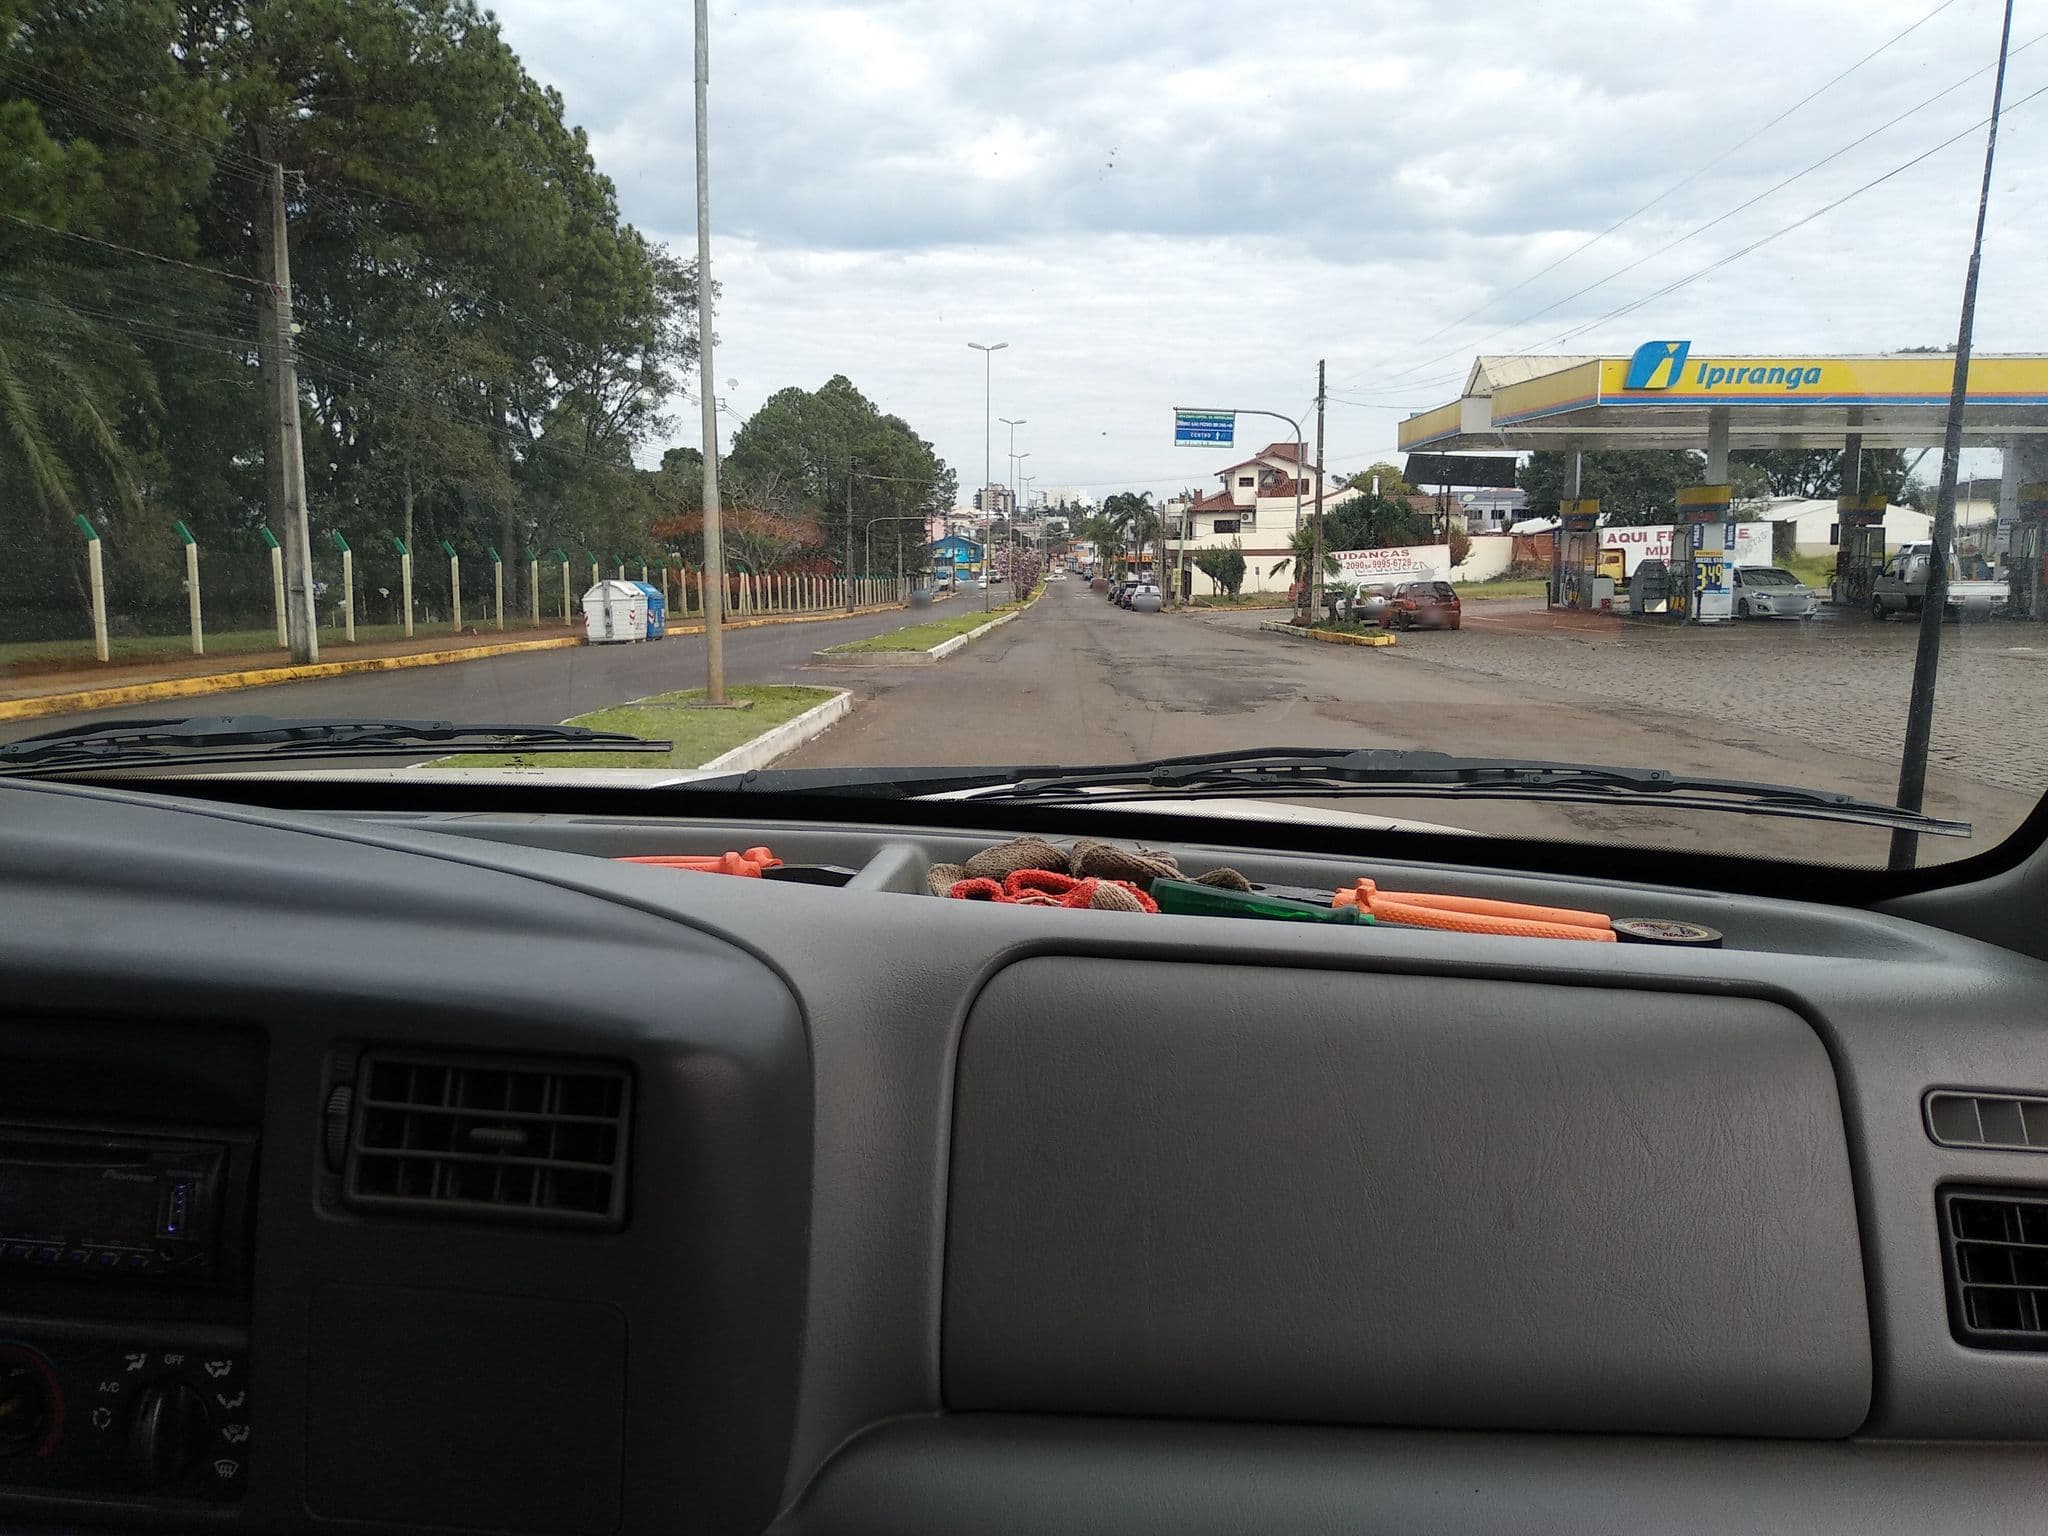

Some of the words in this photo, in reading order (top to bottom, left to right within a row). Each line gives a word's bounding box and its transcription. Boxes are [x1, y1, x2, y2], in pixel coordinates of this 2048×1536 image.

[1696, 362, 1822, 390] Ipiranga
[1607, 532, 1647, 544] AQUI
[163, 1353, 185, 1366] OFF
[99, 1381, 120, 1393] A/C
